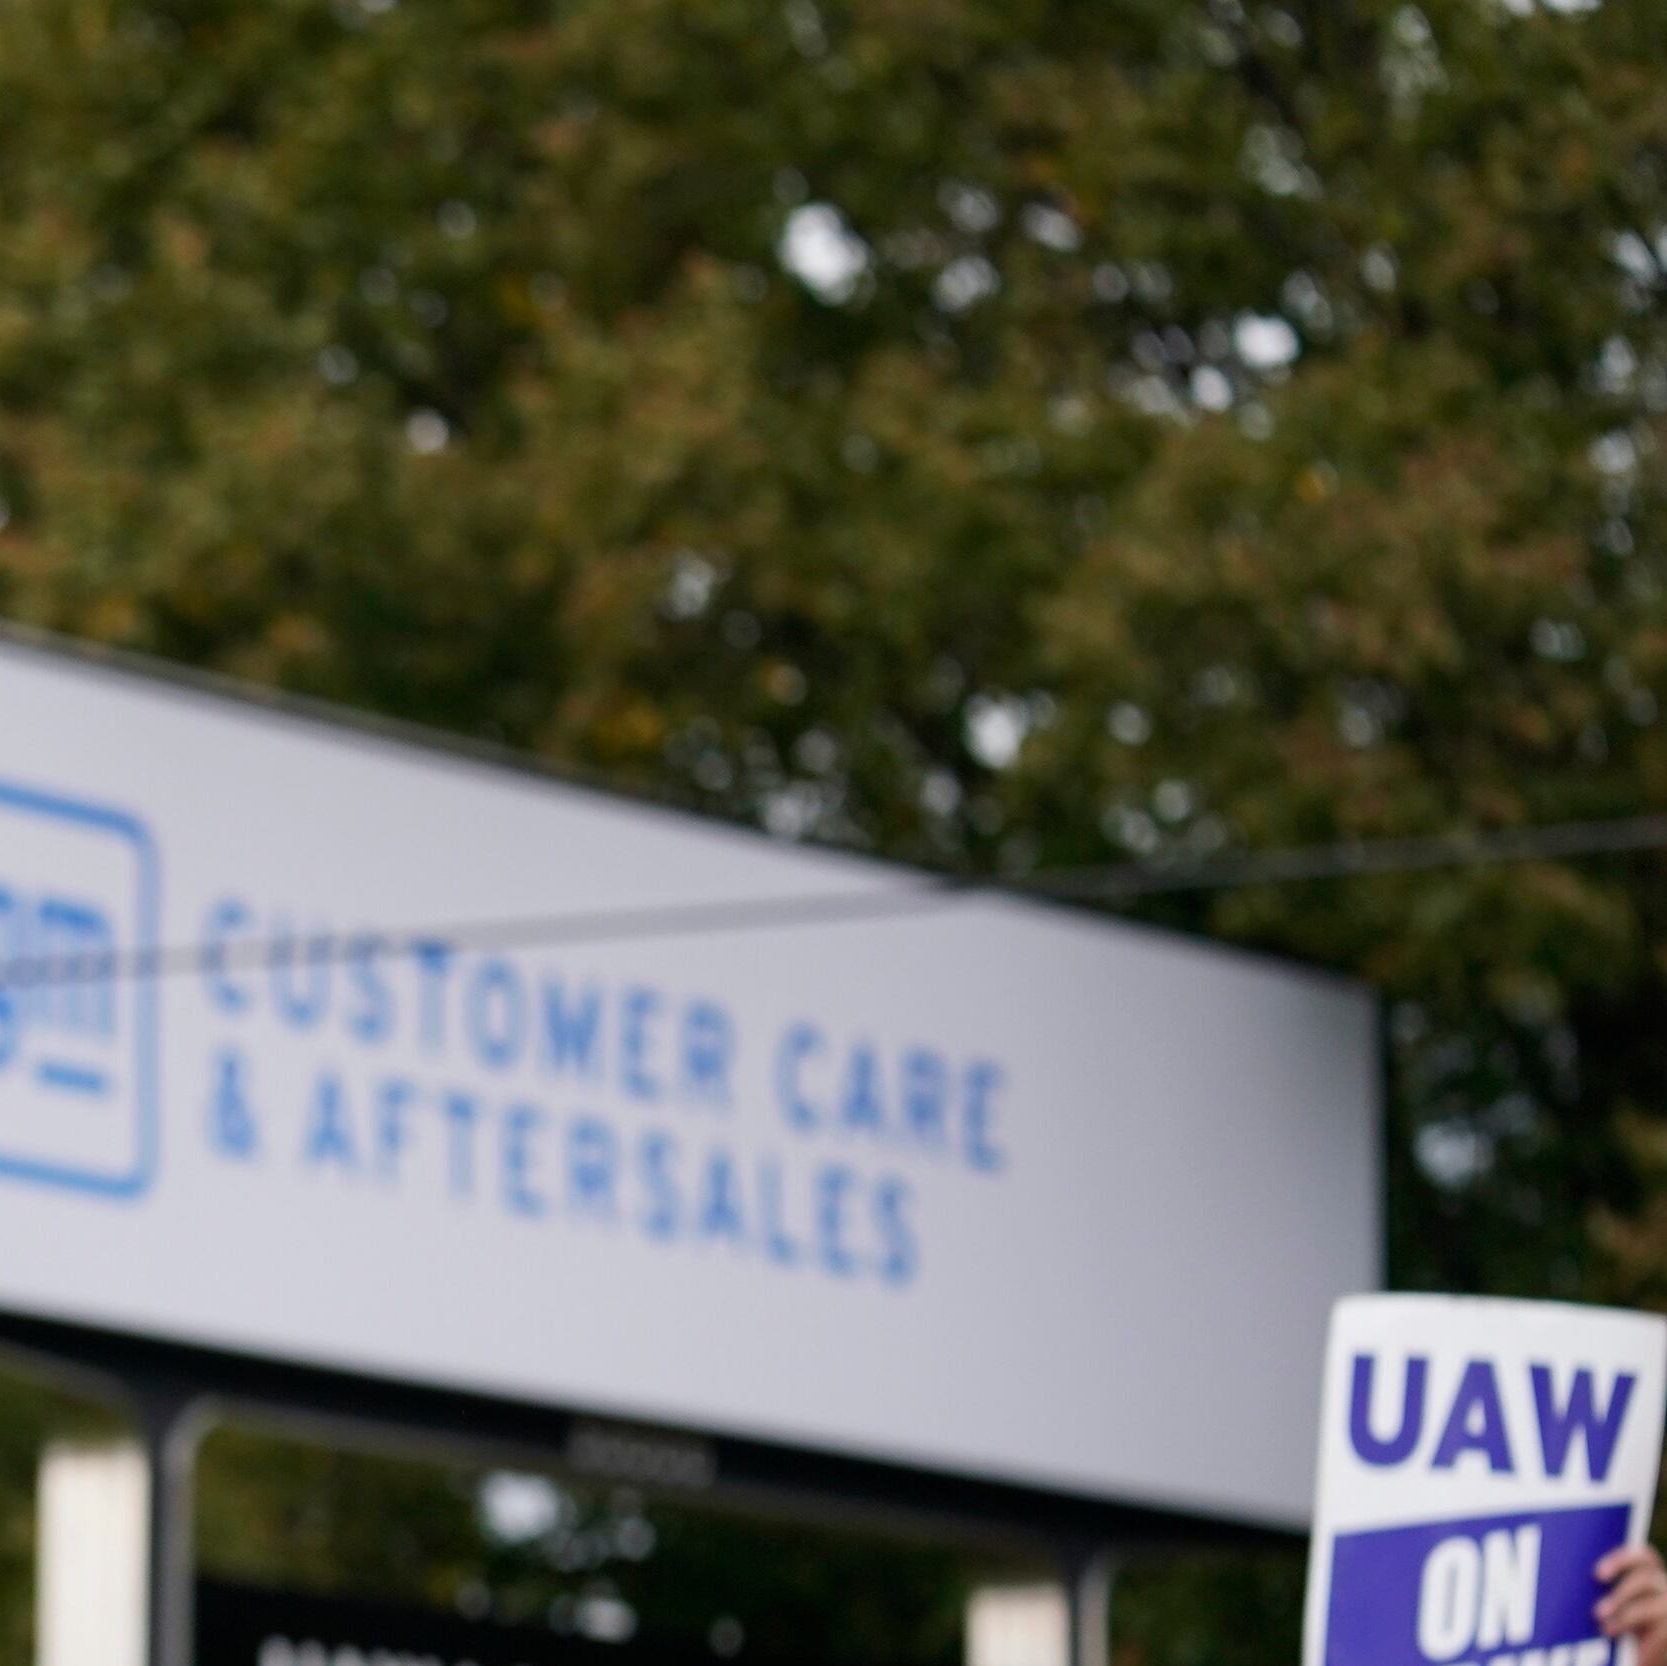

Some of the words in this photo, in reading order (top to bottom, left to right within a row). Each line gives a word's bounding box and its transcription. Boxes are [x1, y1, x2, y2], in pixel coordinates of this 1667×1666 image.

[202, 895, 734, 1112] CUSTOMER
[775, 1020, 1007, 1172] CARE
[207, 1045, 259, 1165] &
[301, 1065, 920, 1286] AFTERSALES
[1349, 1353, 1637, 1483] UAW
[1418, 1523, 1542, 1663] ON
